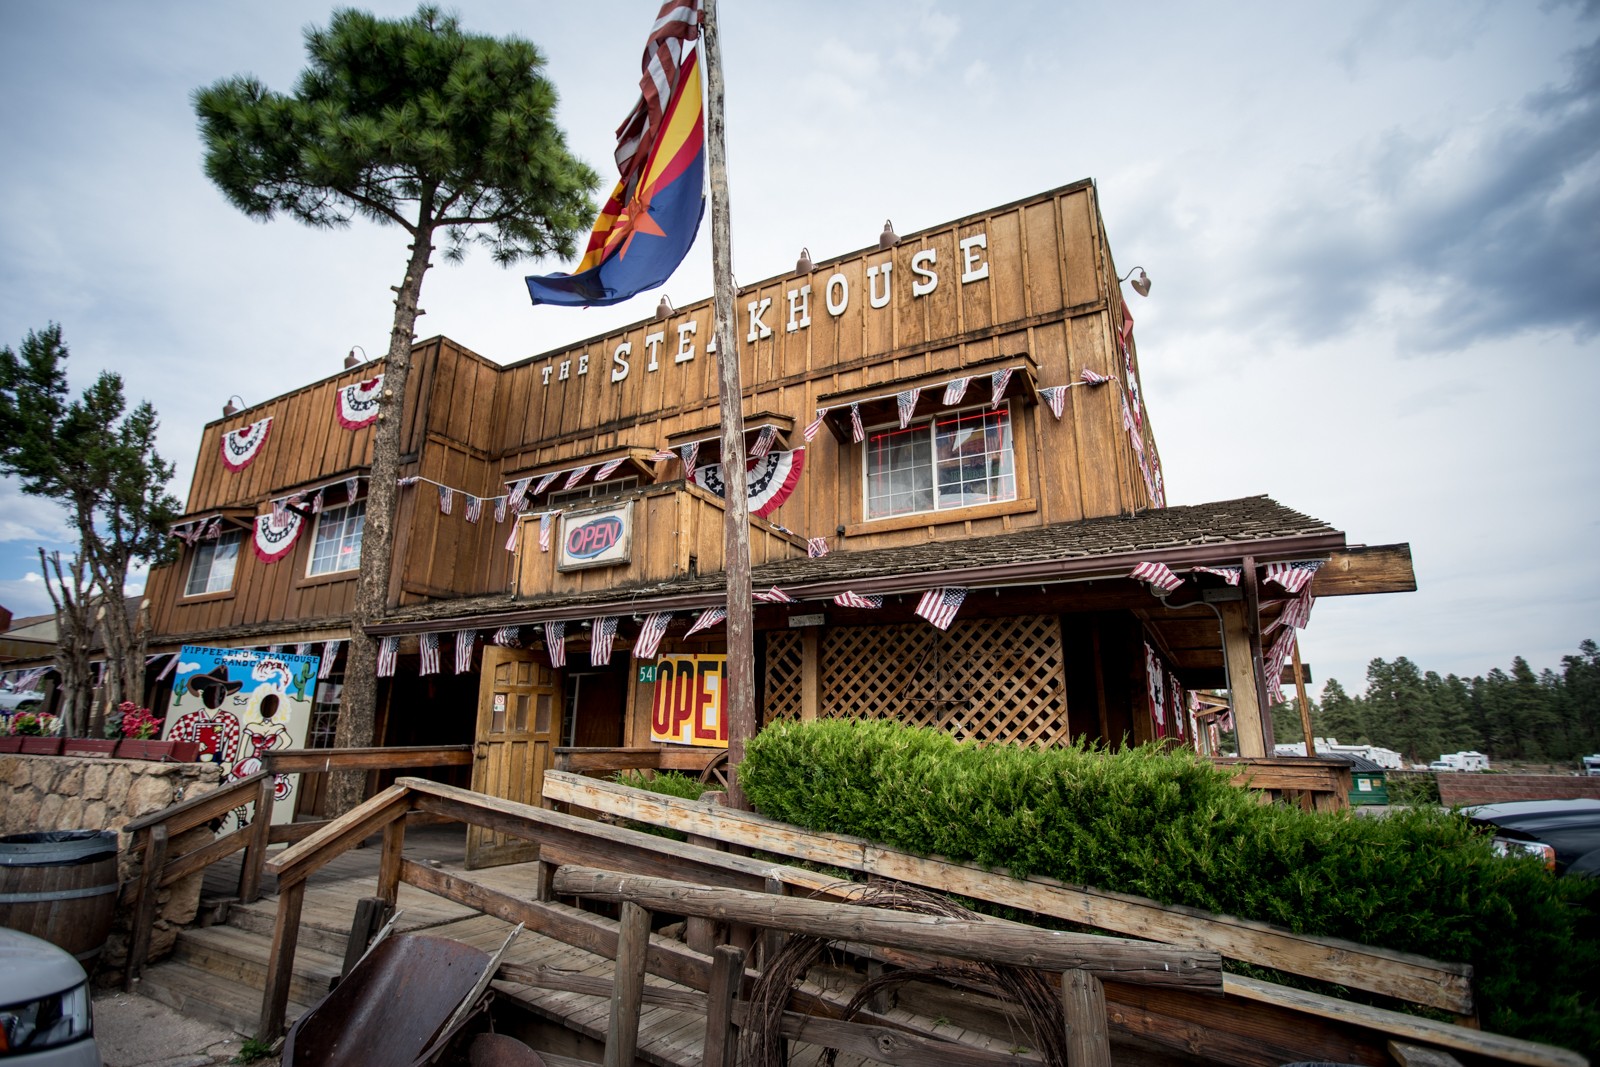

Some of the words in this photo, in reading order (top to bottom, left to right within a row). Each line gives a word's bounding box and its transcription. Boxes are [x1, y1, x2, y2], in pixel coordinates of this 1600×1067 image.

[542, 355, 588, 385] THE
[611, 233, 989, 383] STEKHOUSE
[568, 521, 619, 553] OPEN
[254, 653, 319, 664] STEAKHOUSE
